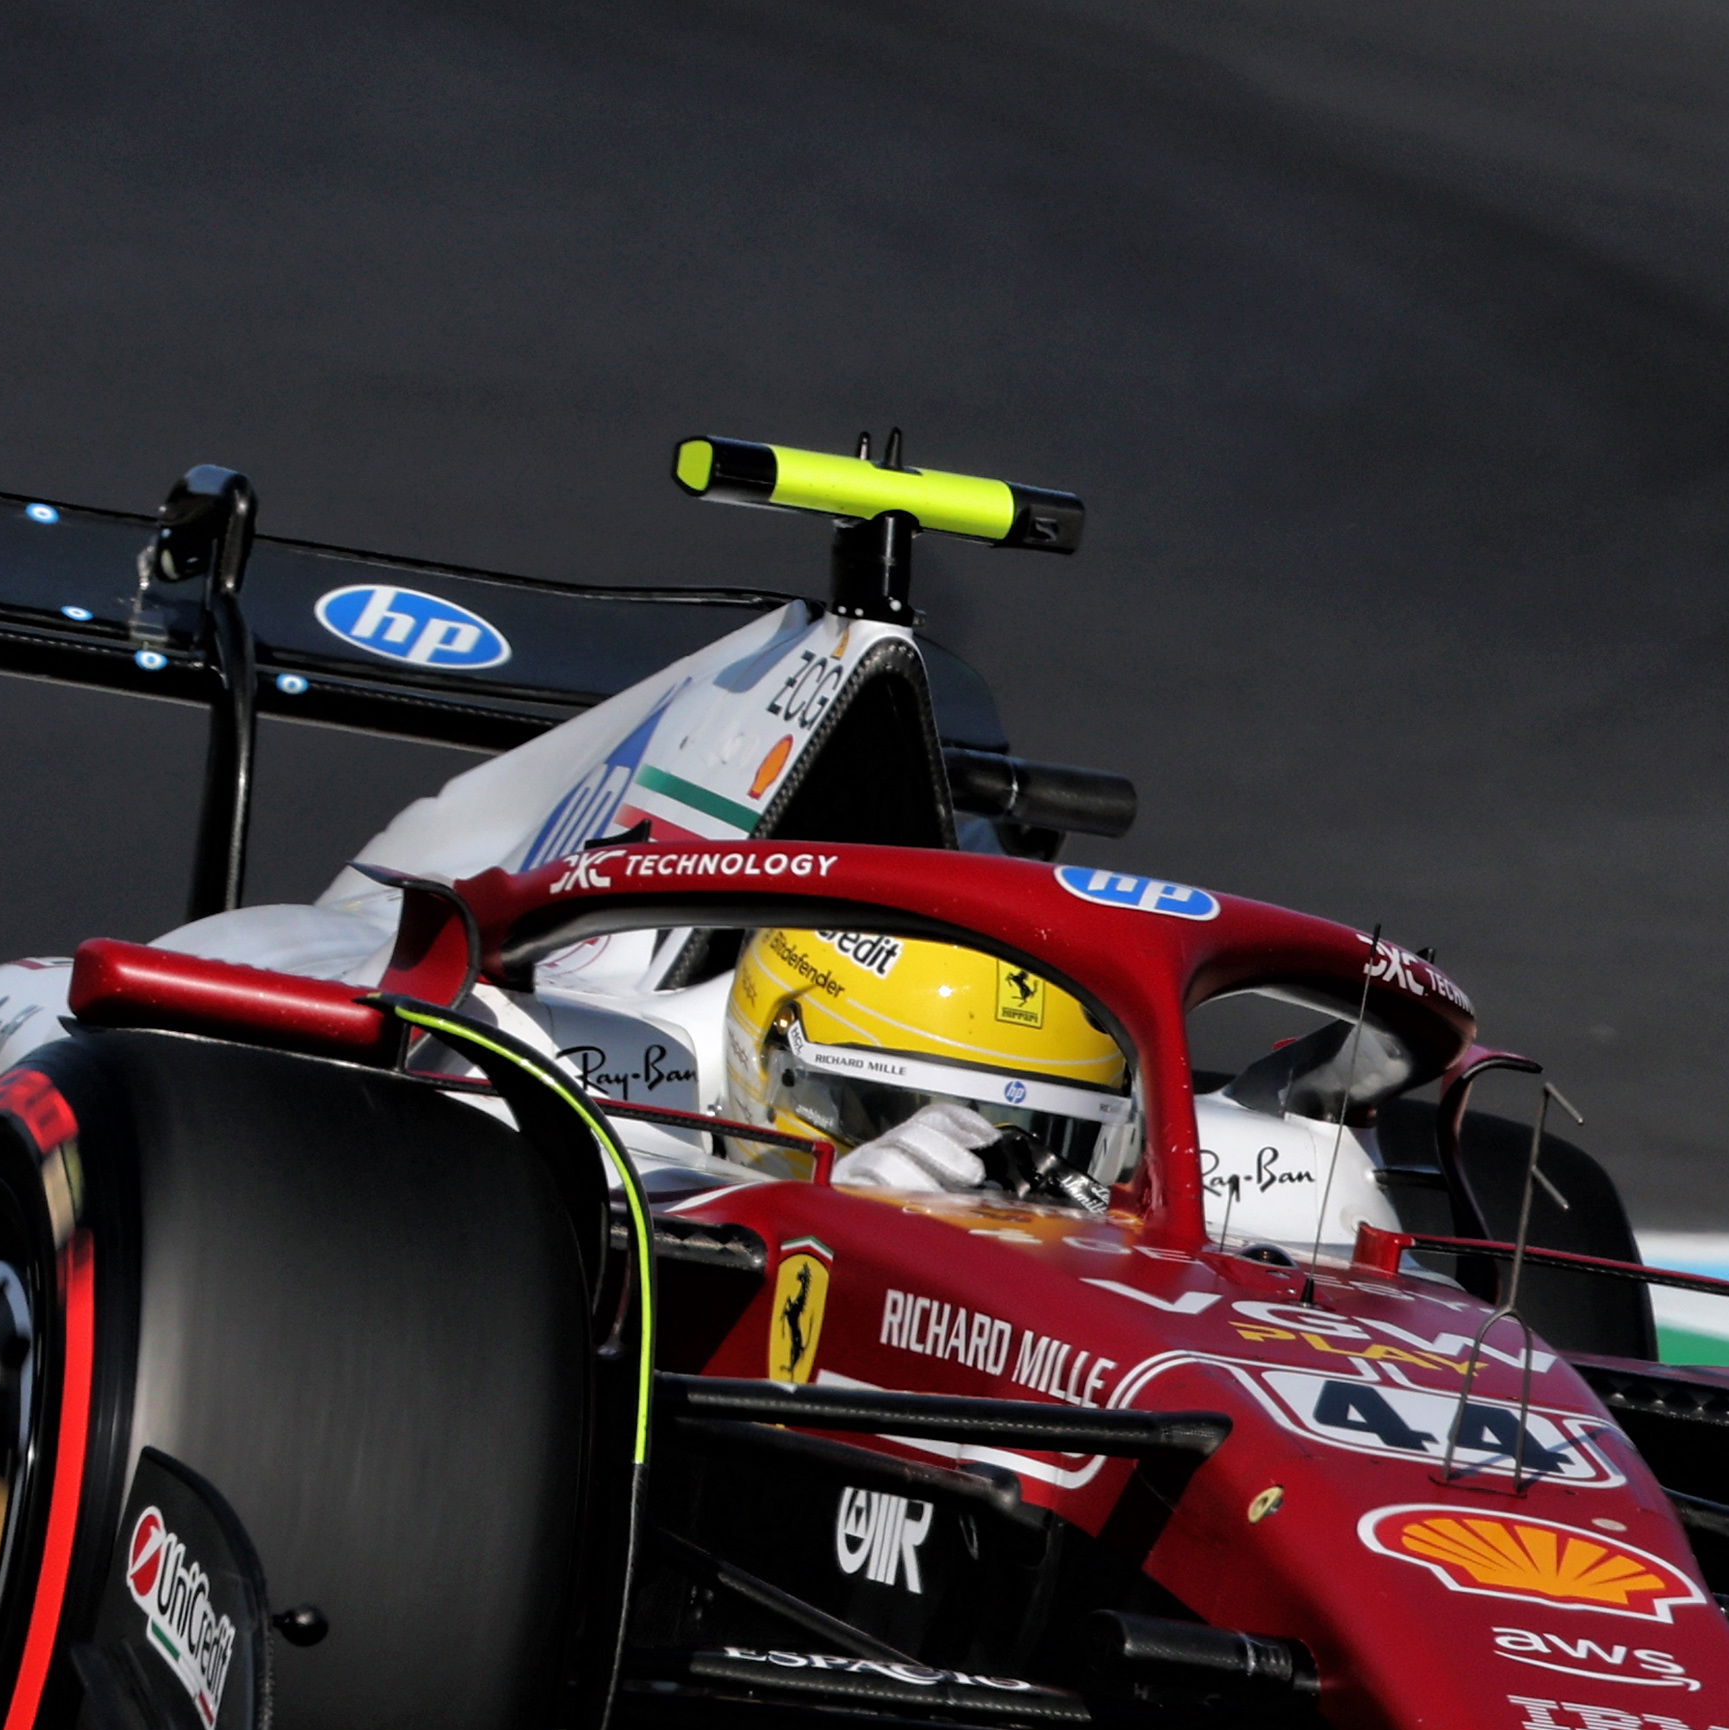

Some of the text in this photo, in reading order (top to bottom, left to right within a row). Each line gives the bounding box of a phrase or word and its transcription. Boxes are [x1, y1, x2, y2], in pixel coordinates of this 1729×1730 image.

[349, 586, 482, 664] hp
[624, 852, 838, 877] TECHNOLOGY
[768, 931, 845, 999] Bitdefender
[555, 1044, 700, 1101] Ray-Ban
[814, 1053, 908, 1077] RICHARD MILLE
[879, 1288, 1119, 1409] RICHARD MILLE
[1079, 1278, 1558, 1373] VGW
[1229, 1320, 1489, 1377] PLAY
[1313, 1379, 1576, 1473] 44
[157, 1540, 232, 1706] UniCredit
[1491, 1626, 1687, 1678] aws
